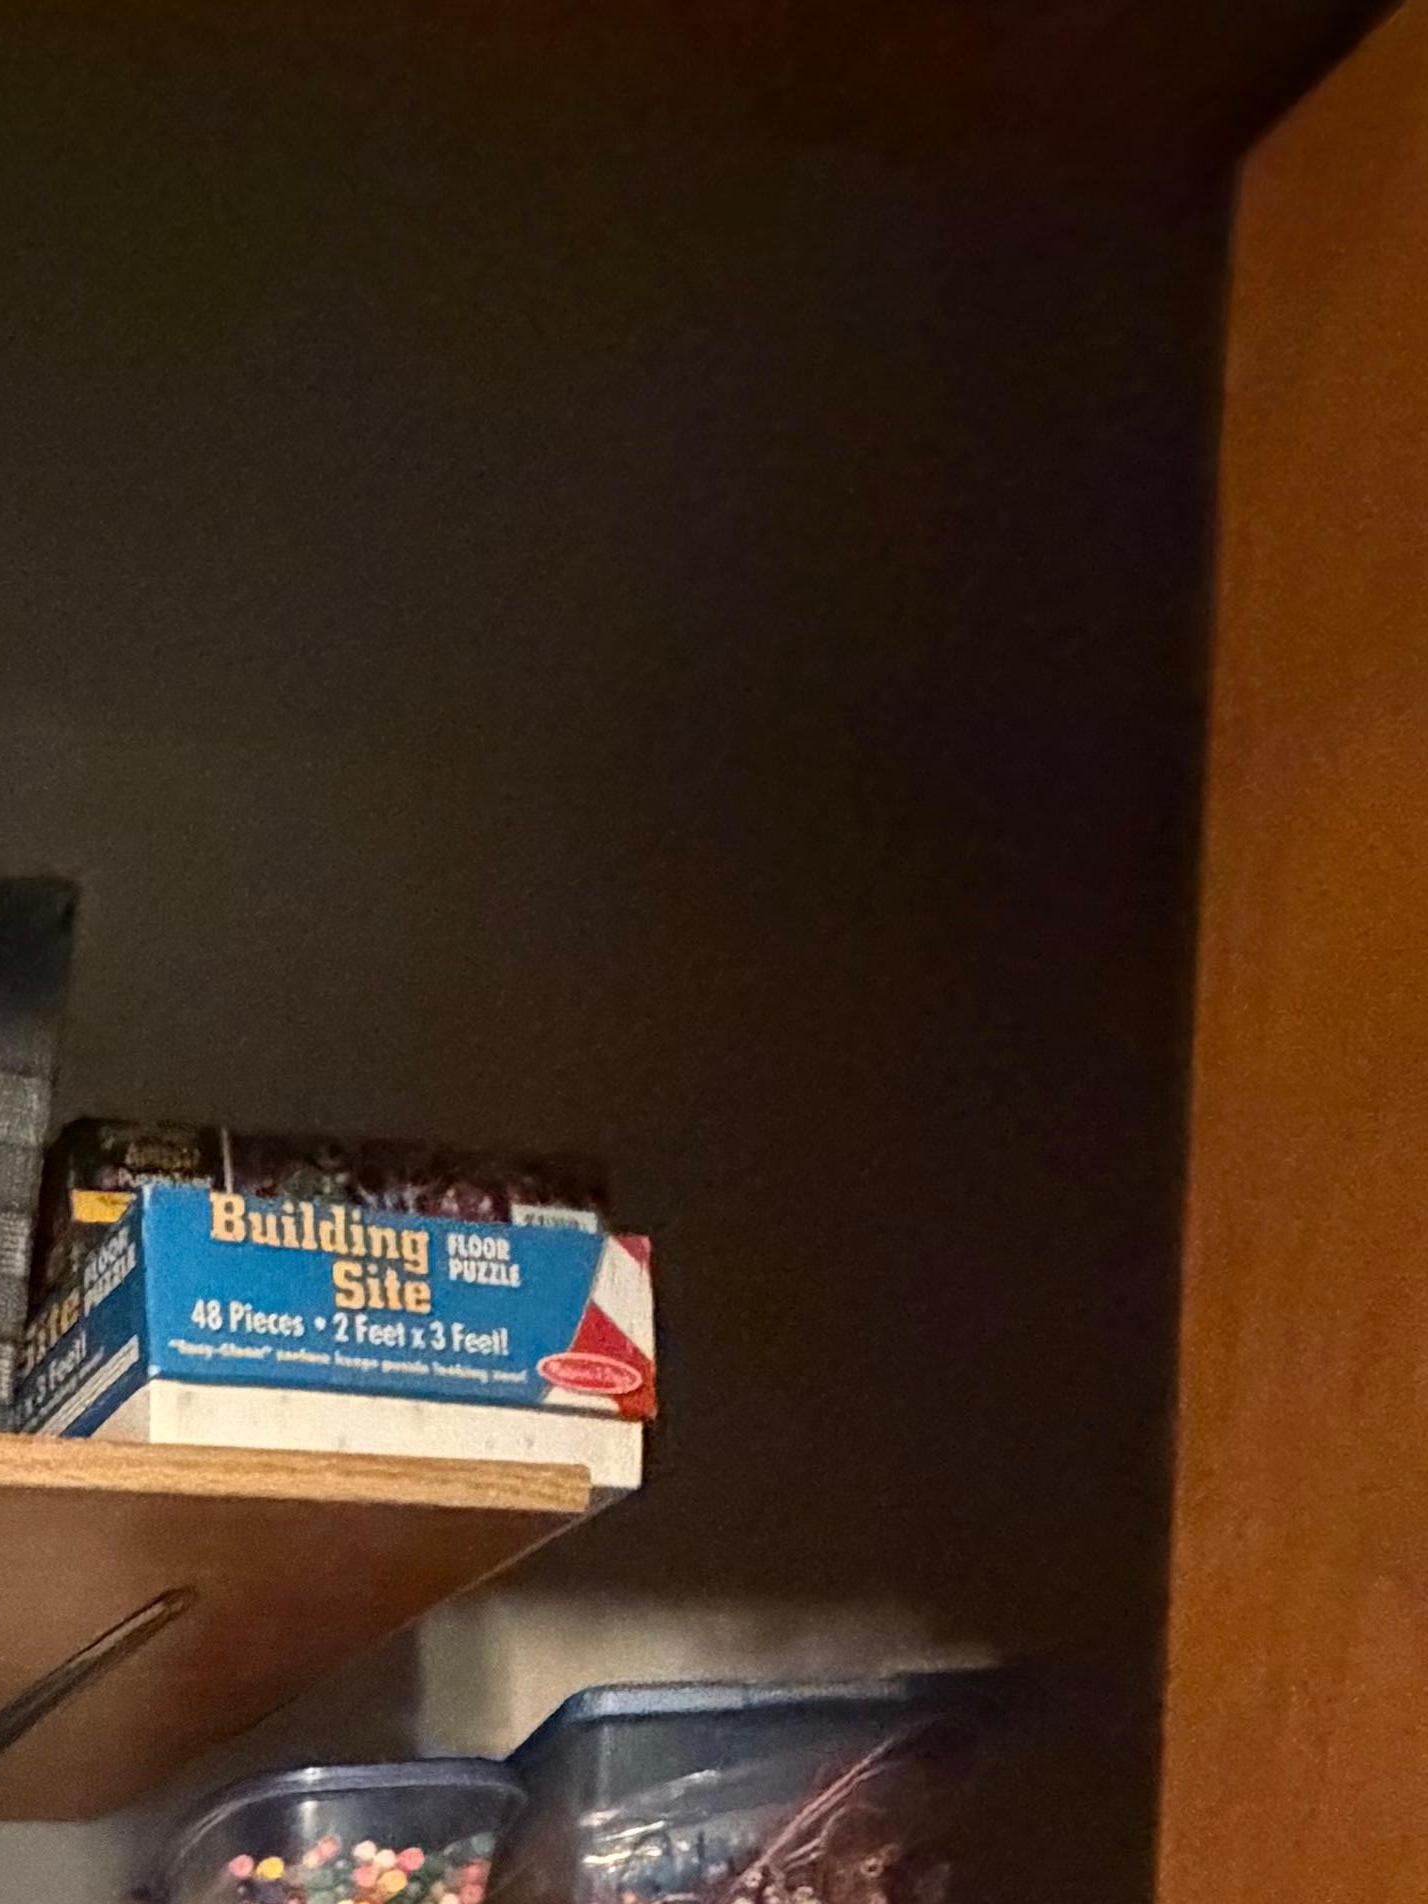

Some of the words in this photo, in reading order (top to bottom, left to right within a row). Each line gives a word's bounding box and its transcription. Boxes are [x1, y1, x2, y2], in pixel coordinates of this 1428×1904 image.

[209, 1190, 431, 1276] Building
[447, 1231, 512, 1264] FLOOR
[330, 1260, 433, 1314] Site
[448, 1260, 522, 1289] PUZZLE
[190, 1298, 224, 1331] 48
[229, 1300, 306, 1339] Pieces
[332, 1311, 349, 1343] 2
[354, 1314, 406, 1349] Feet
[410, 1325, 427, 1350] x
[429, 1318, 448, 1353] 3
[451, 1323, 510, 1358] Feet!
